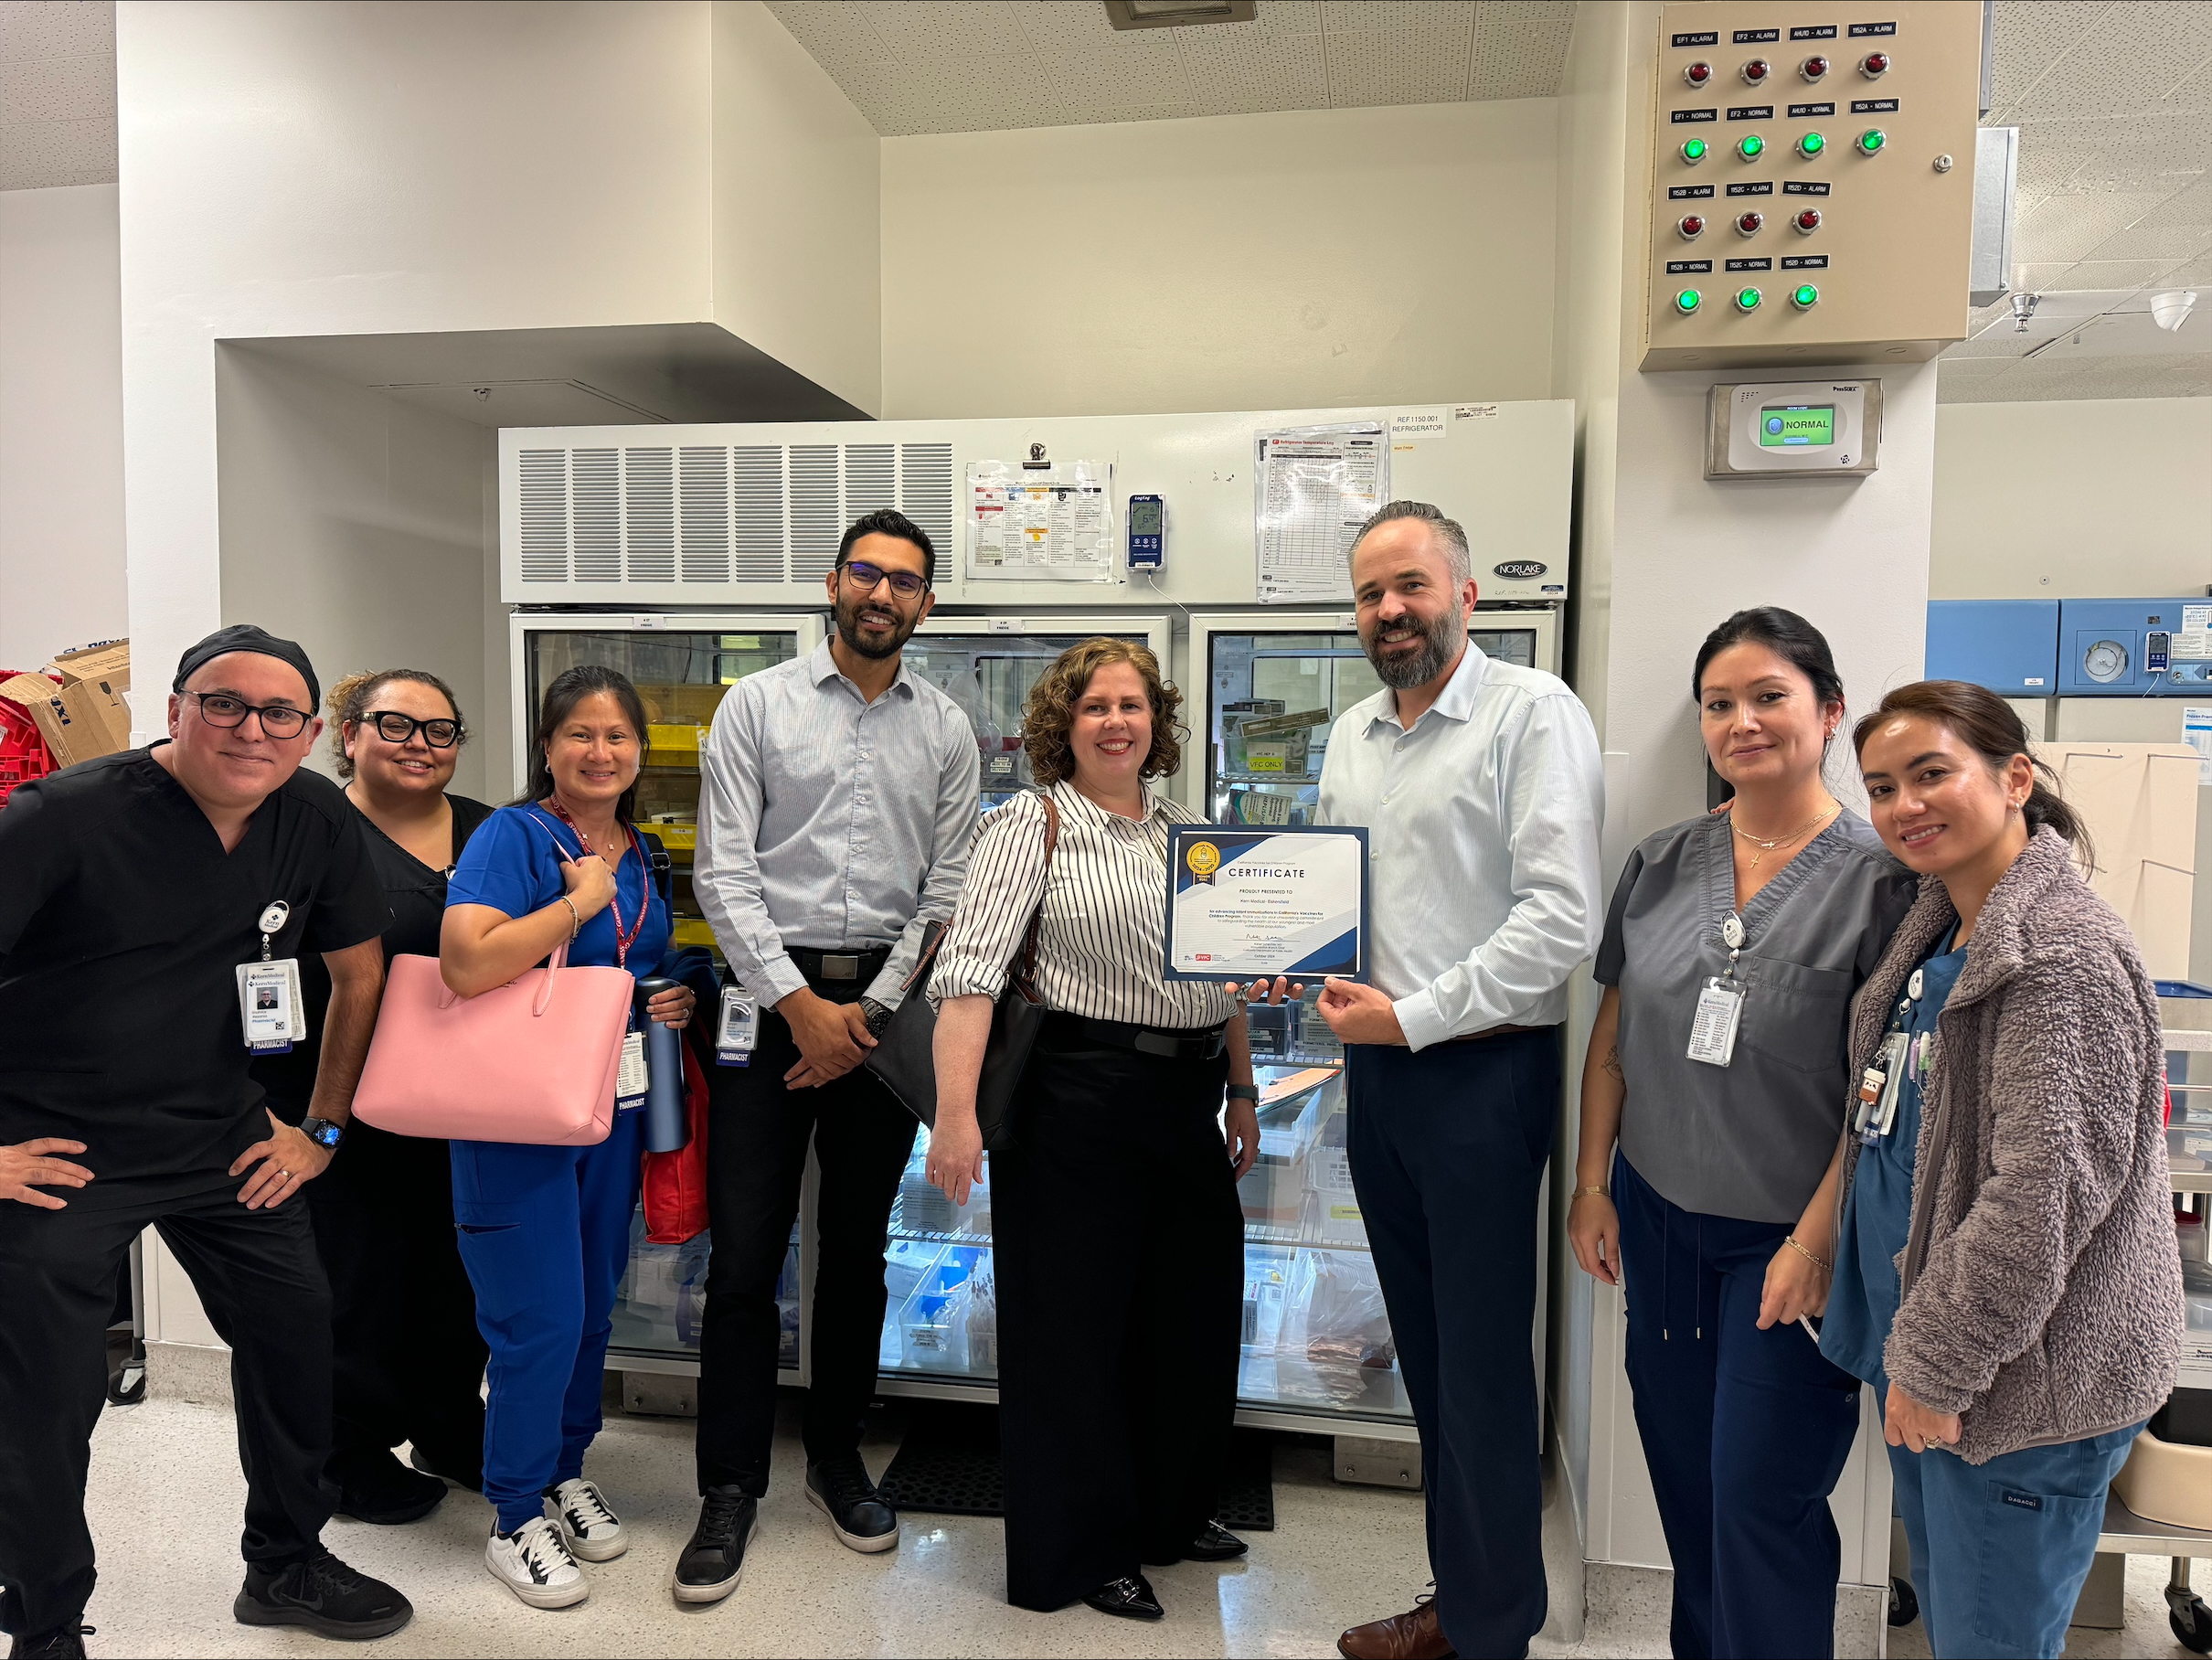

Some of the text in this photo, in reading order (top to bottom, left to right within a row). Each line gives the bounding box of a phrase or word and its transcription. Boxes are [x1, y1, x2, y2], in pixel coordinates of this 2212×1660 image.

[1874, 25, 1893, 33] ALARM
[1676, 35, 1714, 44] EF1 ALARM
[1693, 187, 1711, 196] ALARM
[1392, 424, 1443, 432] REFRIGERATOR
[1786, 420, 1829, 429] NORMAL
[1499, 564, 1541, 576] NORLAKE
[1228, 867, 1305, 878] CERTIFICATE
[252, 1038, 288, 1050] PHARMACIST
[719, 1051, 749, 1062] PHARMACIST
[619, 1097, 645, 1110] PHARMACIST
